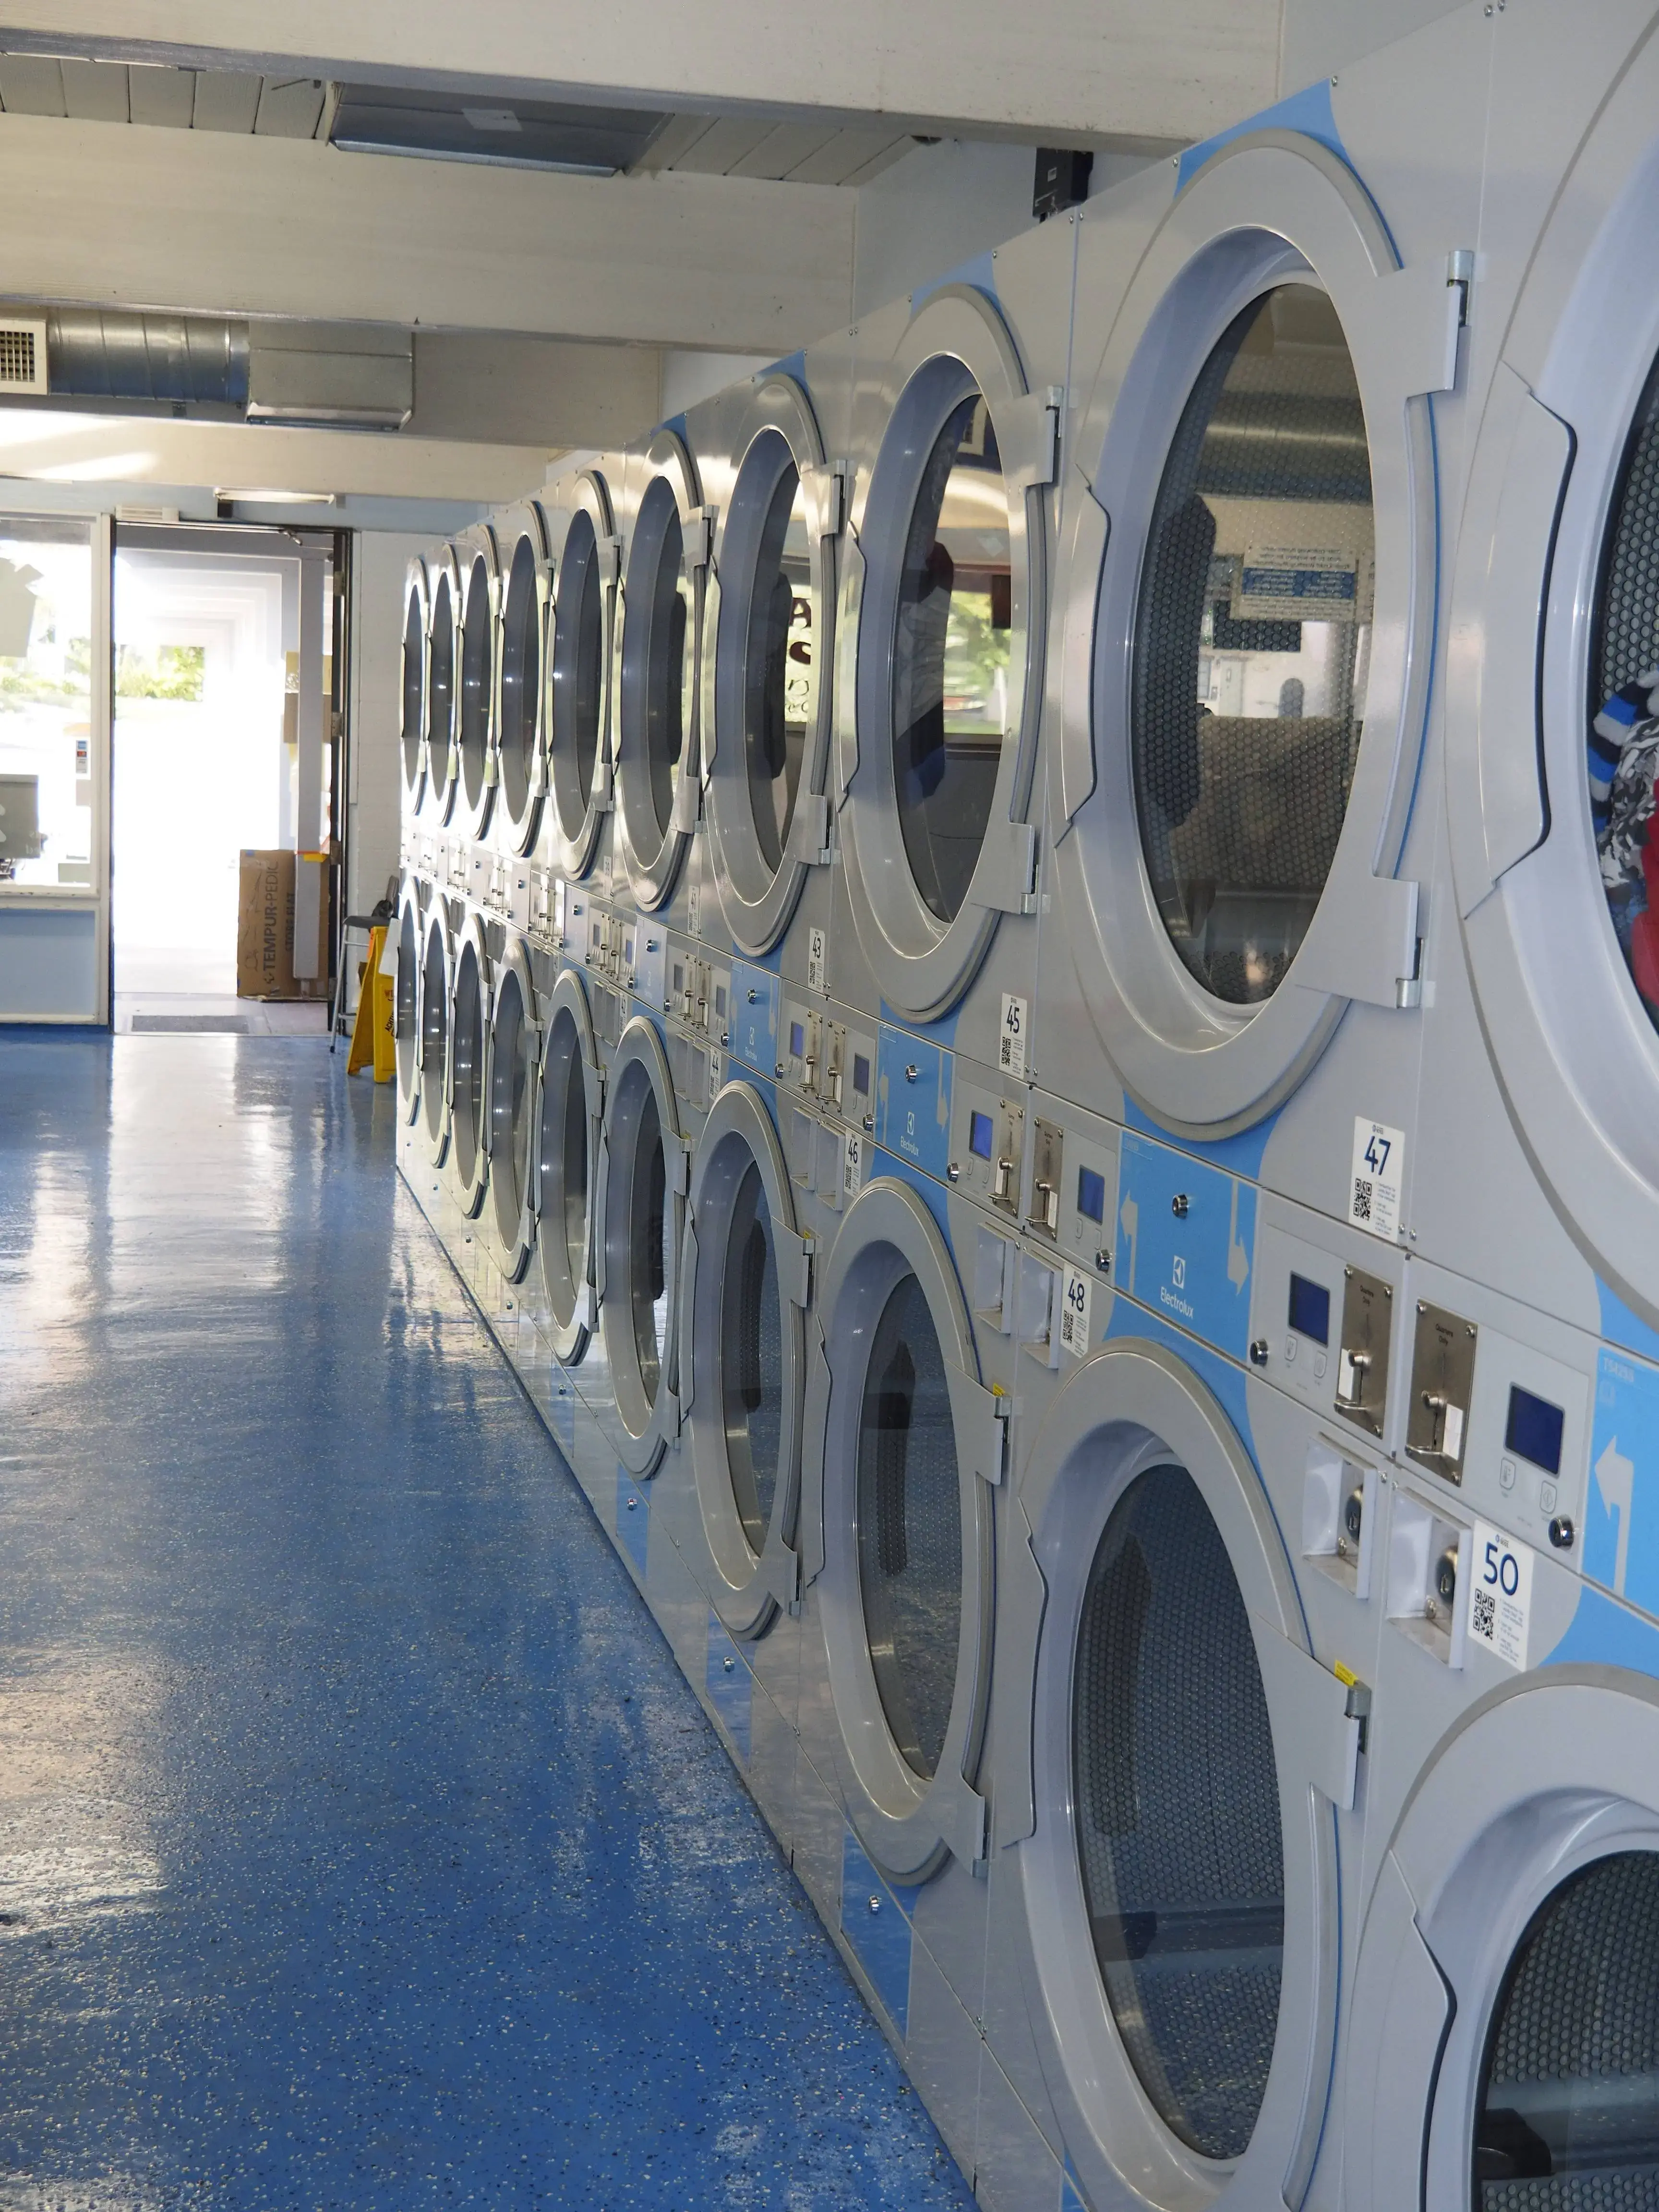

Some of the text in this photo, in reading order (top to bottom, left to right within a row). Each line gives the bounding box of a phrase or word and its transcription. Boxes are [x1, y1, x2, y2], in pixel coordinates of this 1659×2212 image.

[264, 861, 279, 971] TEMPUR-PEDIC
[812, 937, 821, 959] 43
[1006, 1005, 1020, 1034] 45
[712, 1055, 719, 1075] 44
[848, 1139, 858, 1164] 46
[1364, 1135, 1391, 1176] 47
[1068, 1278, 1085, 1312] 48
[1160, 1286, 1194, 1320] Electrolux
[1483, 1541, 1519, 1596] 50
